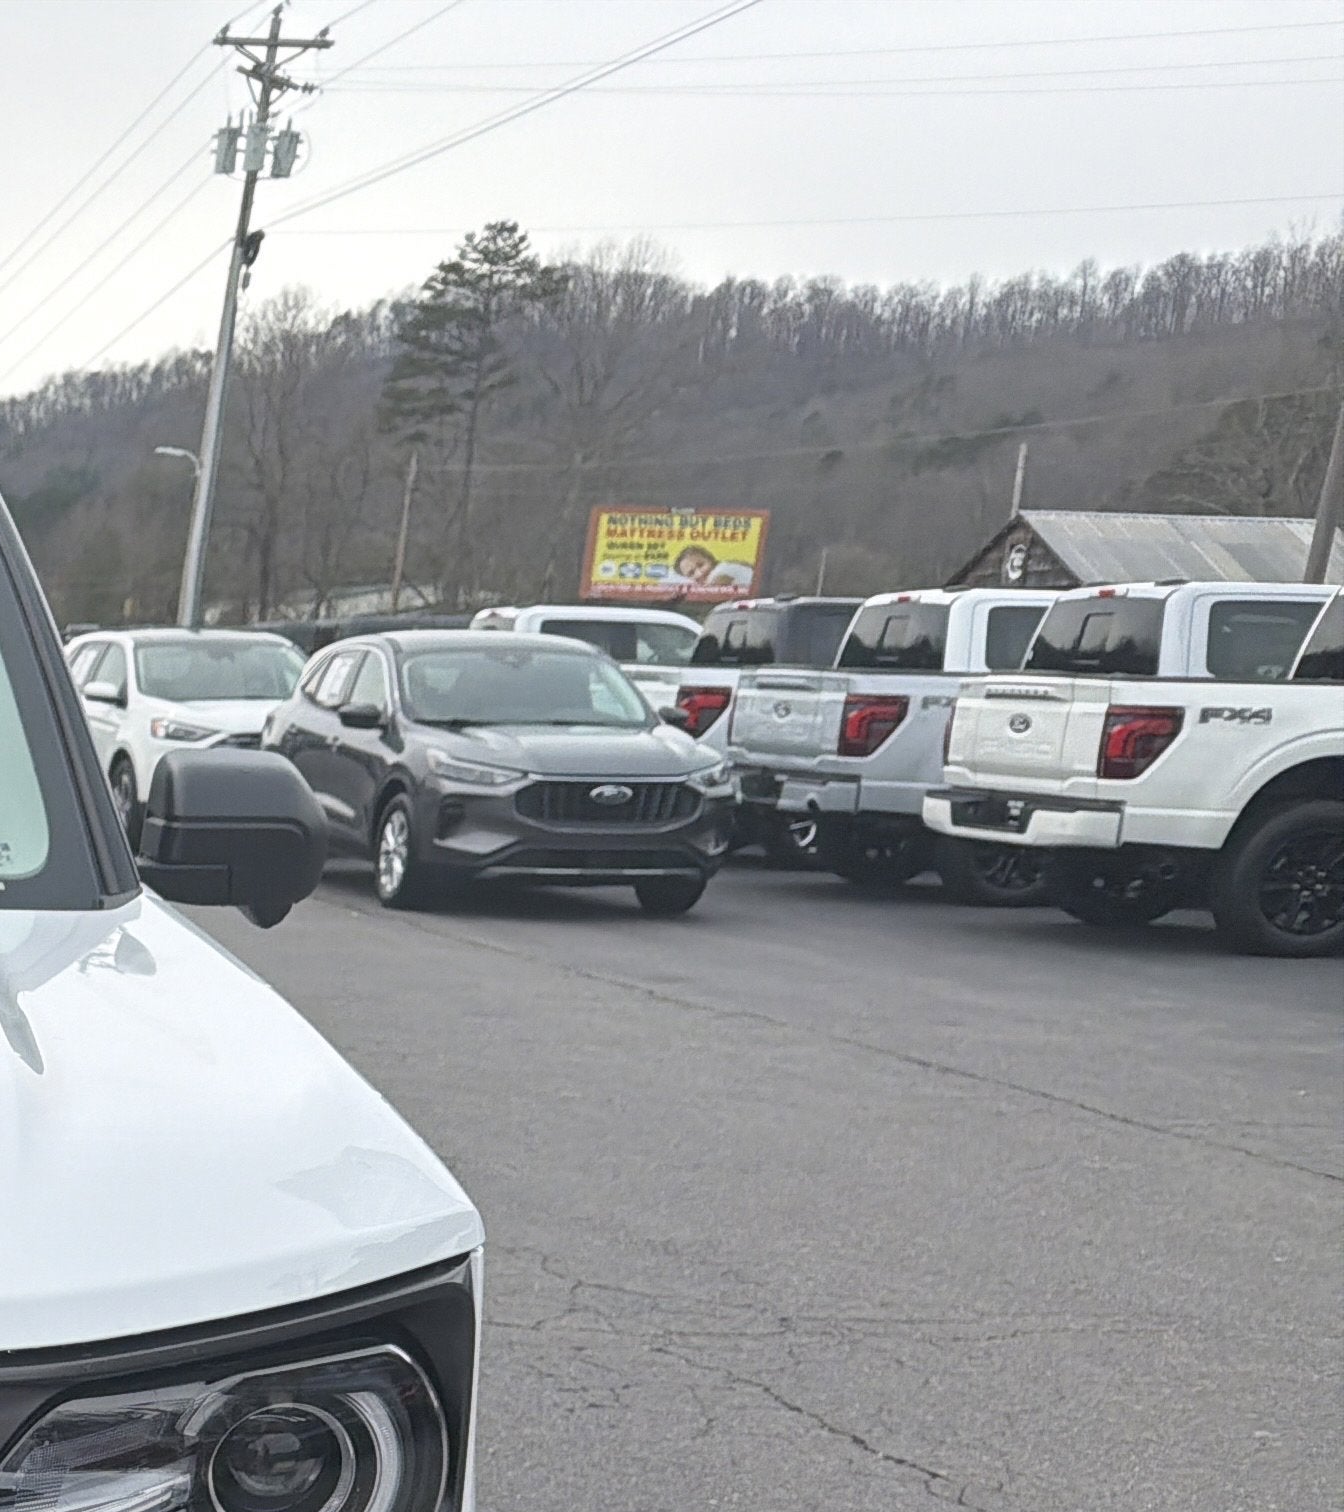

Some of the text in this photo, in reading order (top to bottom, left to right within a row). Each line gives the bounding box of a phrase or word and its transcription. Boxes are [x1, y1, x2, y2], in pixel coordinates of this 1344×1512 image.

[607, 514, 674, 528] NOTHING
[679, 516, 708, 529] BUT
[606, 527, 748, 542] MATTRESS OUTLET
[1198, 707, 1272, 725] FX4
